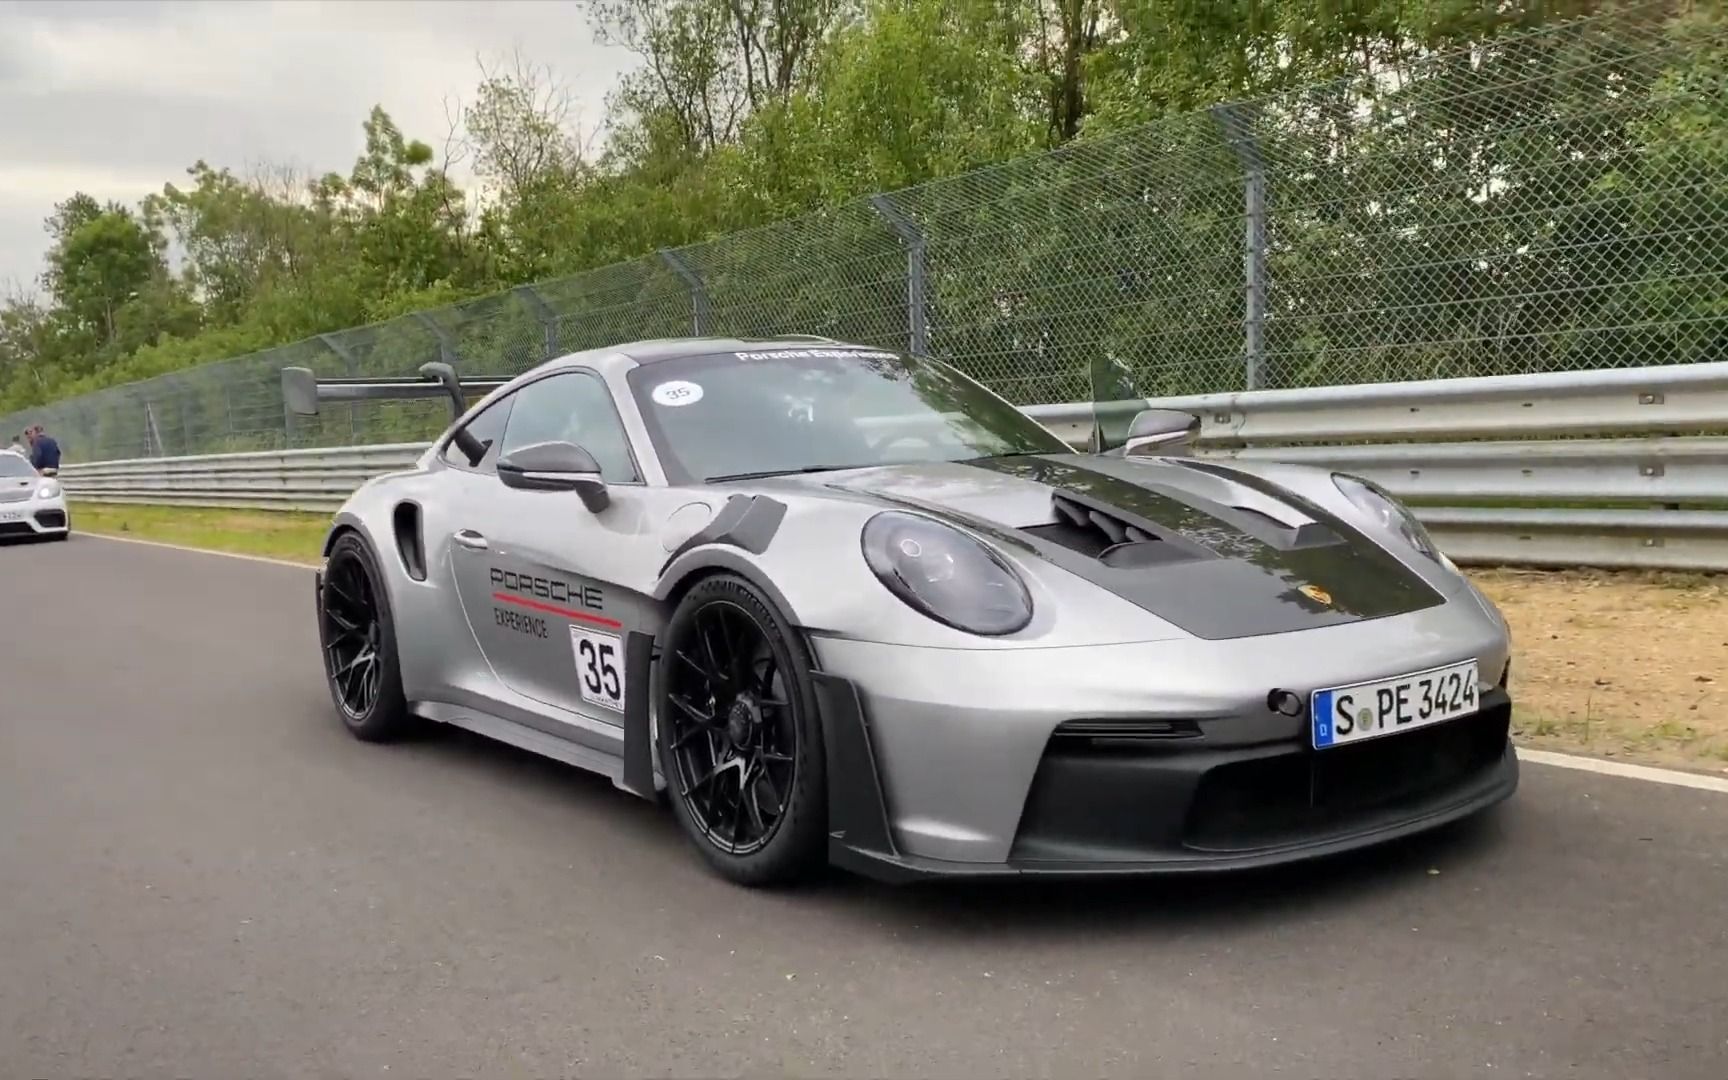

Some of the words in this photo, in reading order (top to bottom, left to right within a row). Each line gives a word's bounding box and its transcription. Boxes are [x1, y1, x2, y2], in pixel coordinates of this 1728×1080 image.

[664, 387, 690, 400] 35
[490, 568, 603, 610] PORSCHE
[494, 607, 548, 639] EXPERIENCE
[579, 638, 621, 701] 35
[1336, 694, 1354, 735] S
[1377, 684, 1413, 729] PE
[1419, 669, 1475, 719] 3424
